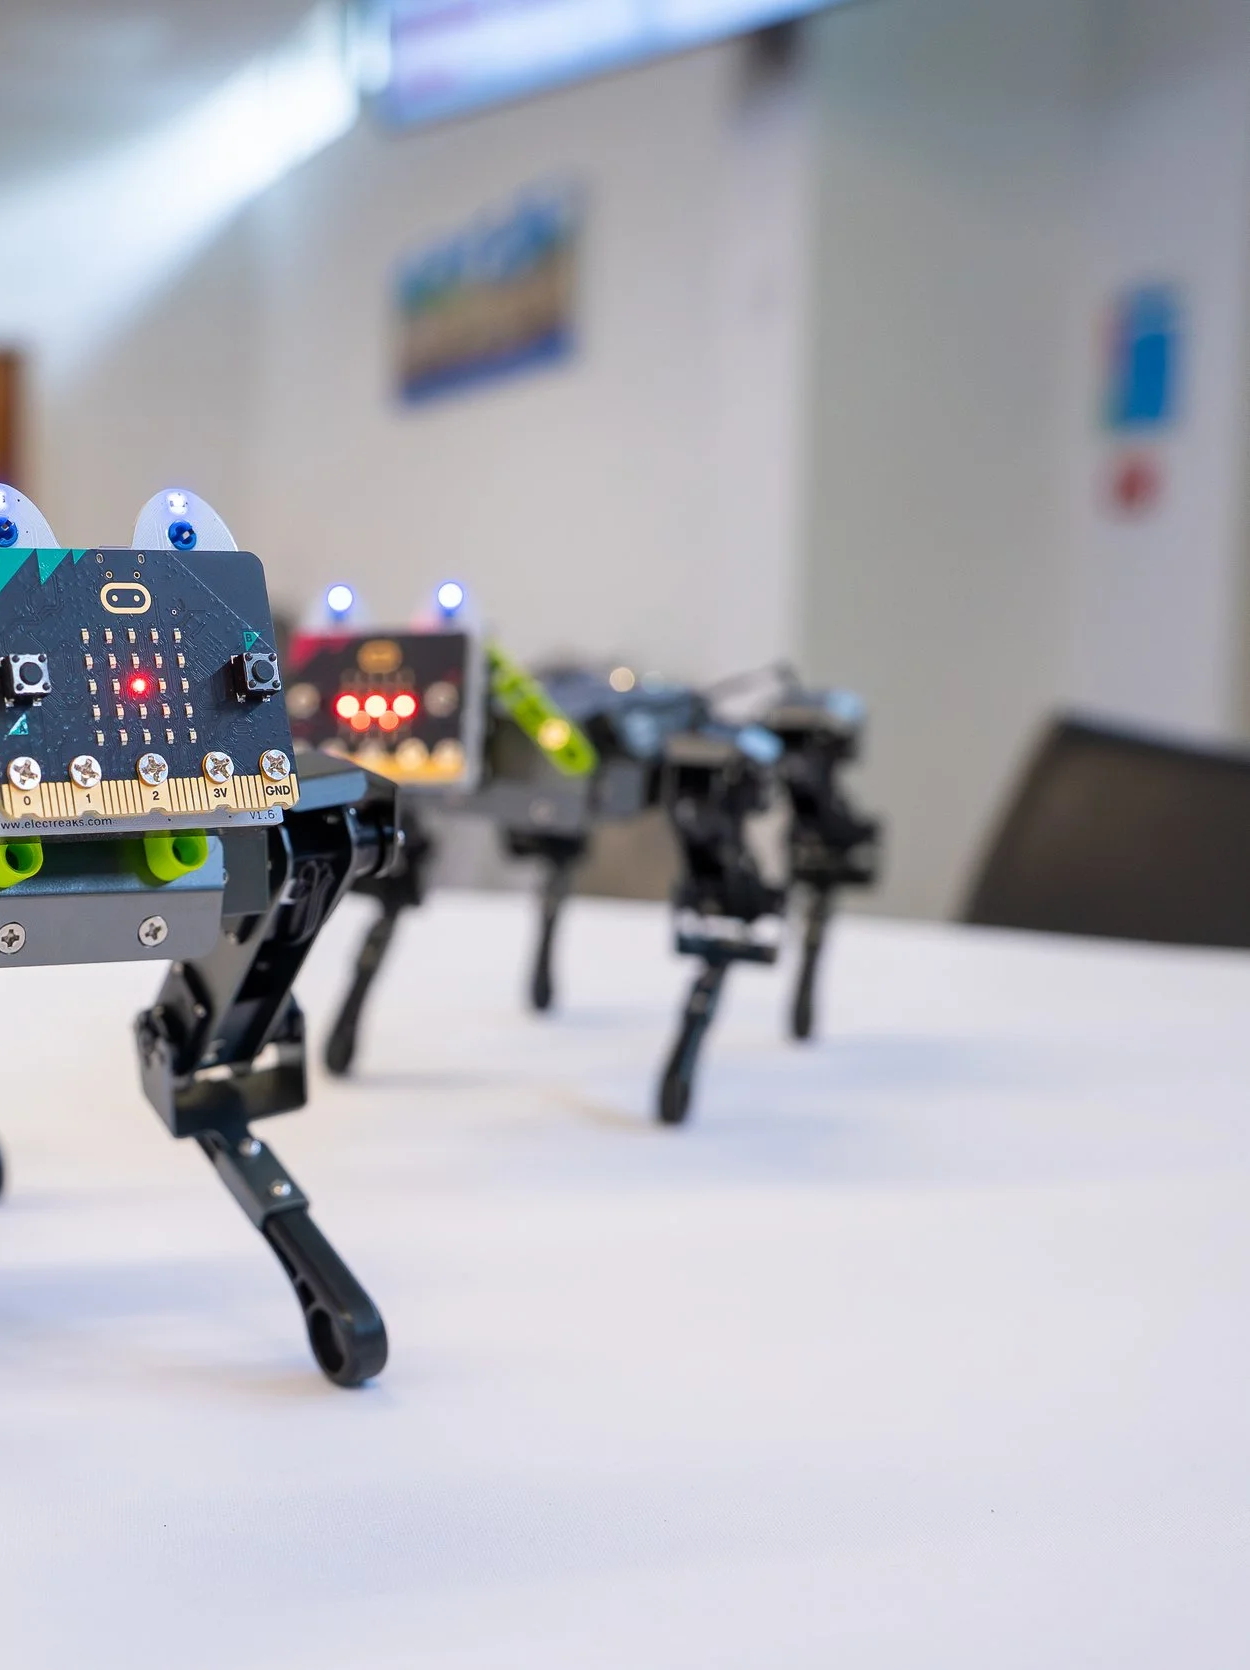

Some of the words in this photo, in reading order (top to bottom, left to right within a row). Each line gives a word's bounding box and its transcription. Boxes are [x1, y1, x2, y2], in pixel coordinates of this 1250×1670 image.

[245, 633, 253, 642] B
[23, 796, 31, 806] 0
[85, 793, 92, 804] 1
[152, 790, 160, 801] 2
[213, 787, 228, 798] 3V
[265, 785, 291, 796] GND
